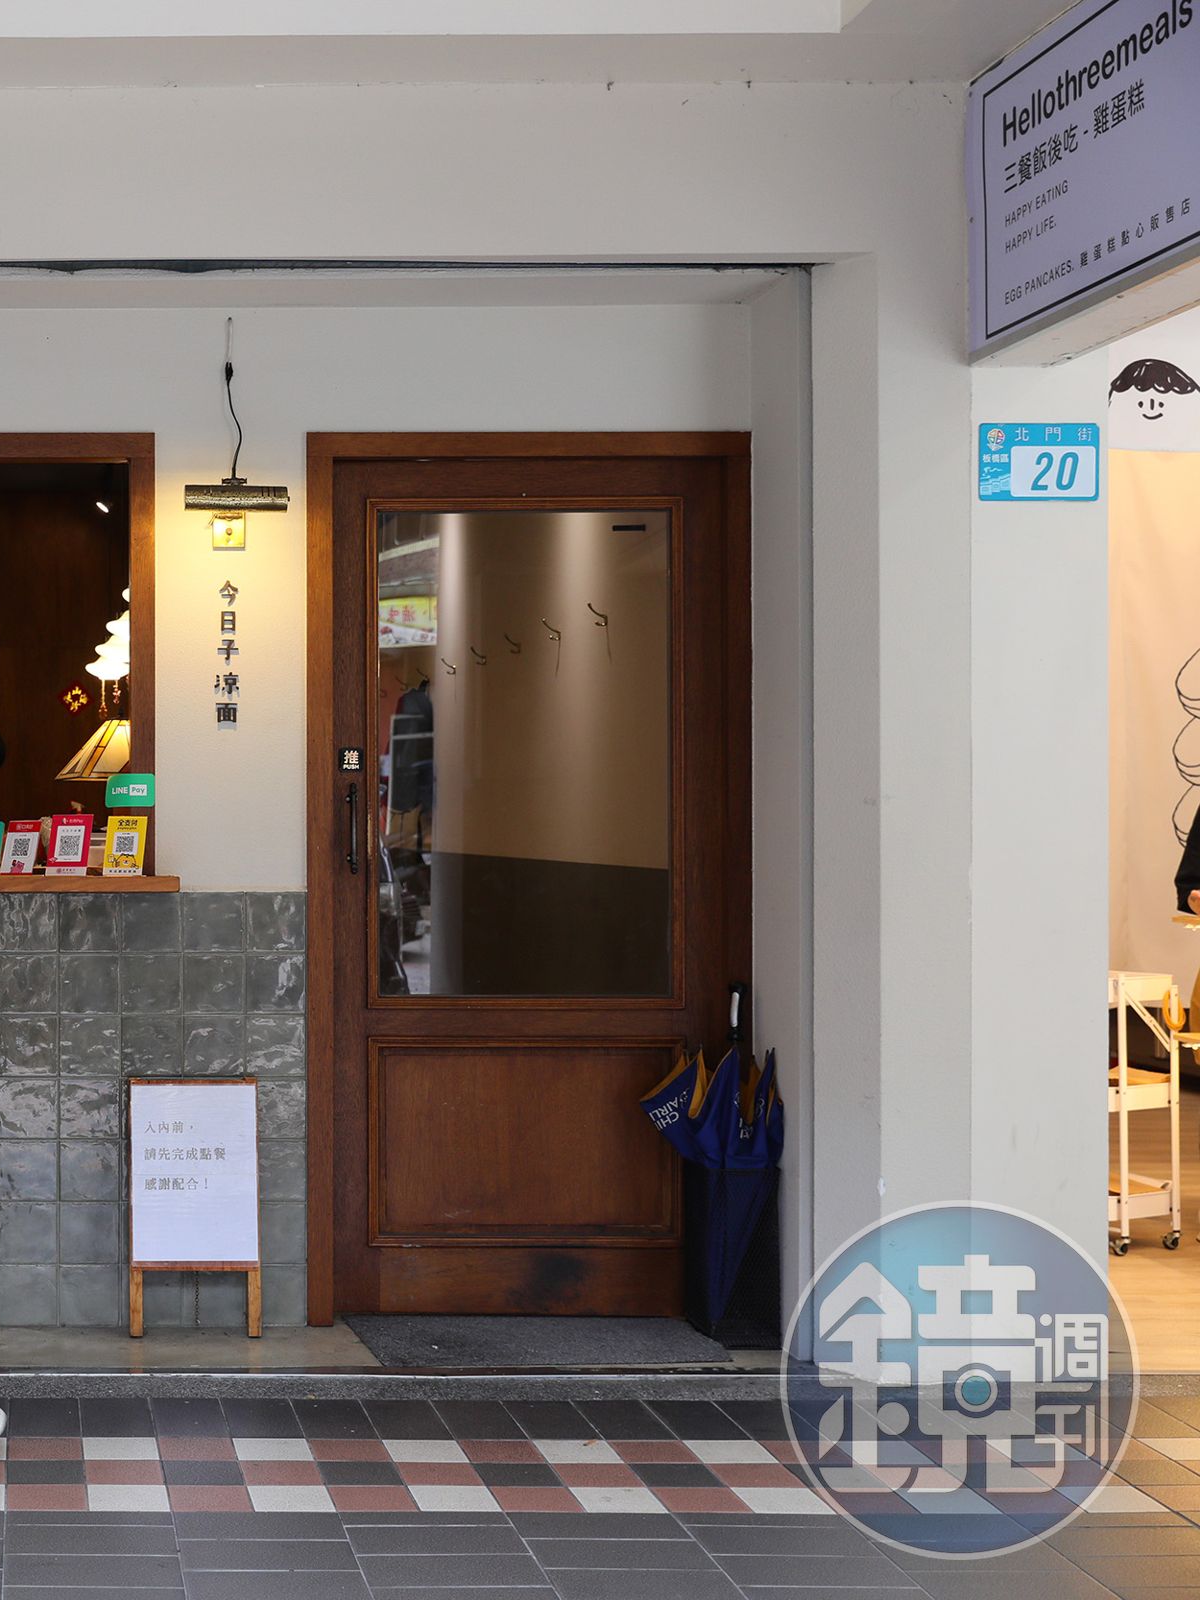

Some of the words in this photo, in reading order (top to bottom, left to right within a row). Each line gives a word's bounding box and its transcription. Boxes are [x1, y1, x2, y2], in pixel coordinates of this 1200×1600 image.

[1002, 0, 1193, 148] Hellothreemeals
[1003, 124, 1079, 194] 三餐飯後吃
[1093, 79, 1145, 139] 雞蛋糕
[1004, 202, 1033, 228] HAPPY
[1035, 180, 1069, 211] EATING
[1004, 228, 1034, 254] HAPPY
[1004, 288, 1023, 305] EGG
[1014, 427, 1092, 441] 北門街
[1030, 451, 1079, 491] 20
[213, 580, 240, 725] 今日子涼面
[343, 750, 359, 764] 推
[111, 786, 128, 795] LINE
[131, 786, 145, 794] Pay
[118, 819, 138, 827] 全支付
[144, 1147, 226, 1161] 請先完成點餐
